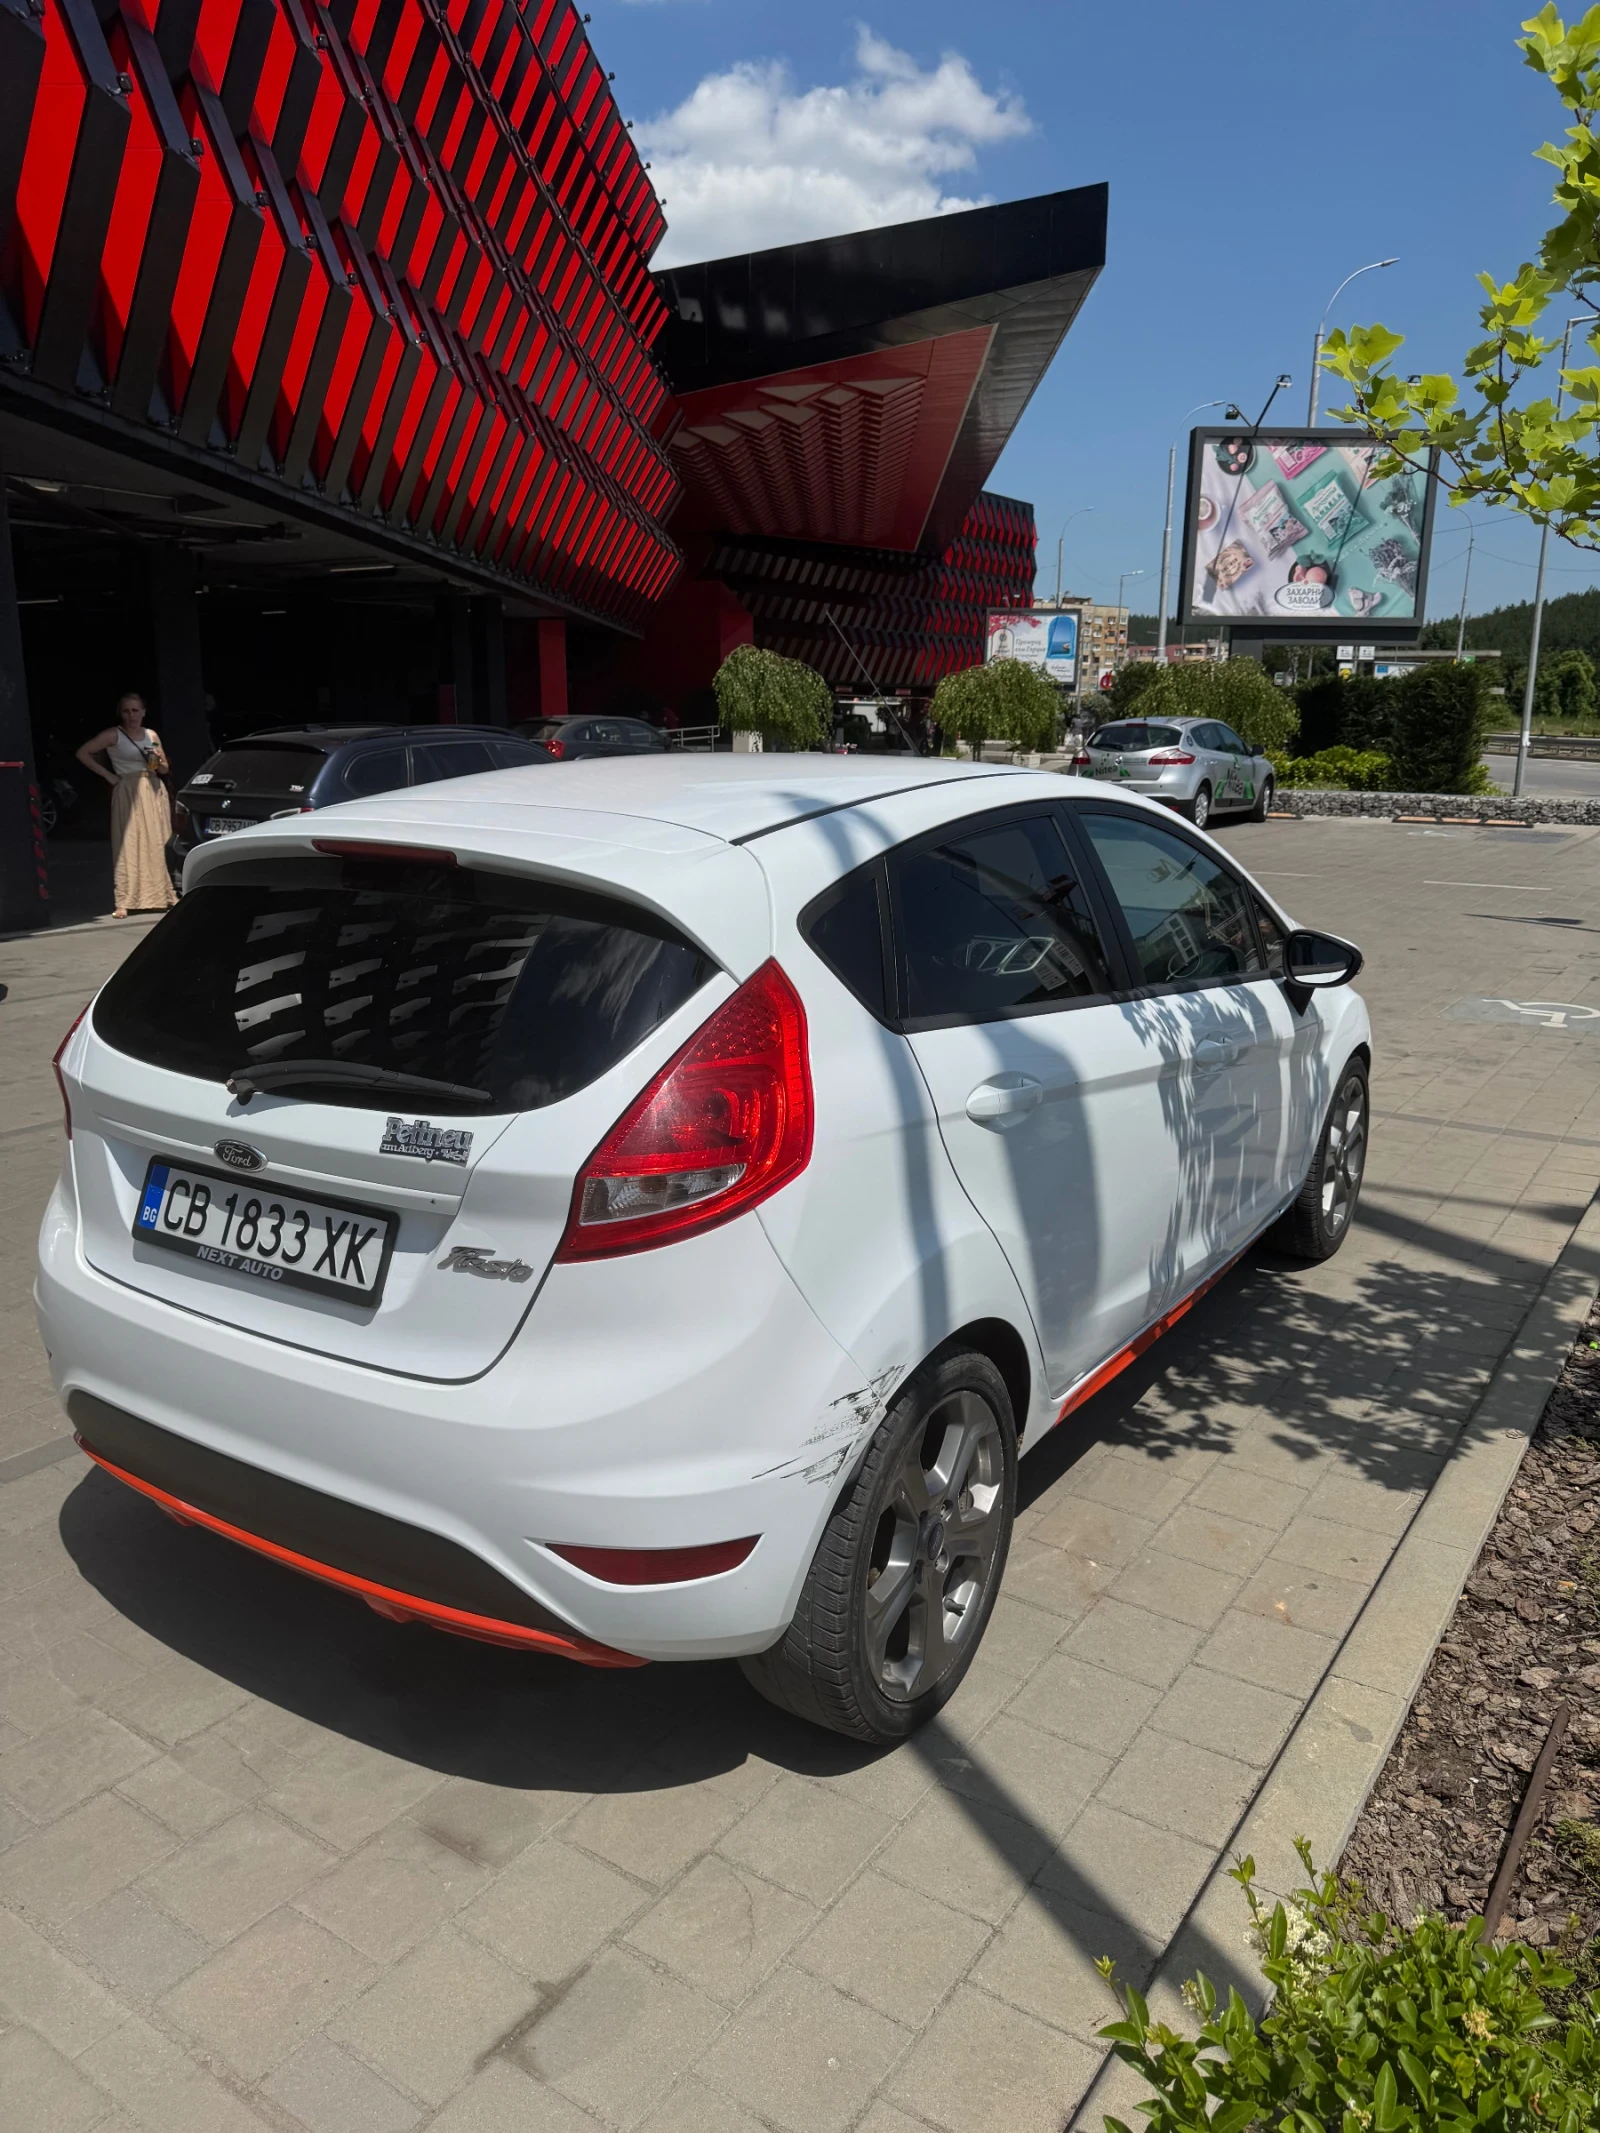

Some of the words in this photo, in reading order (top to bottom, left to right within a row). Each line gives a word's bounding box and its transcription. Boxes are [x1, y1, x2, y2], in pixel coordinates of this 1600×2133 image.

[1286, 587, 1324, 596] ЗАХАРНИ
[1287, 596, 1321, 604] ЗАВОДИ
[1095, 764, 1118, 776] Nitea
[382, 1116, 474, 1150] Pettneu
[222, 1145, 252, 1168] Ford
[142, 1205, 157, 1224] BG
[163, 1179, 212, 1237] CB
[220, 1192, 311, 1265] 1833
[312, 1216, 378, 1285] XK
[196, 1245, 239, 1268] NEXT
[239, 1258, 284, 1282] AUTO
